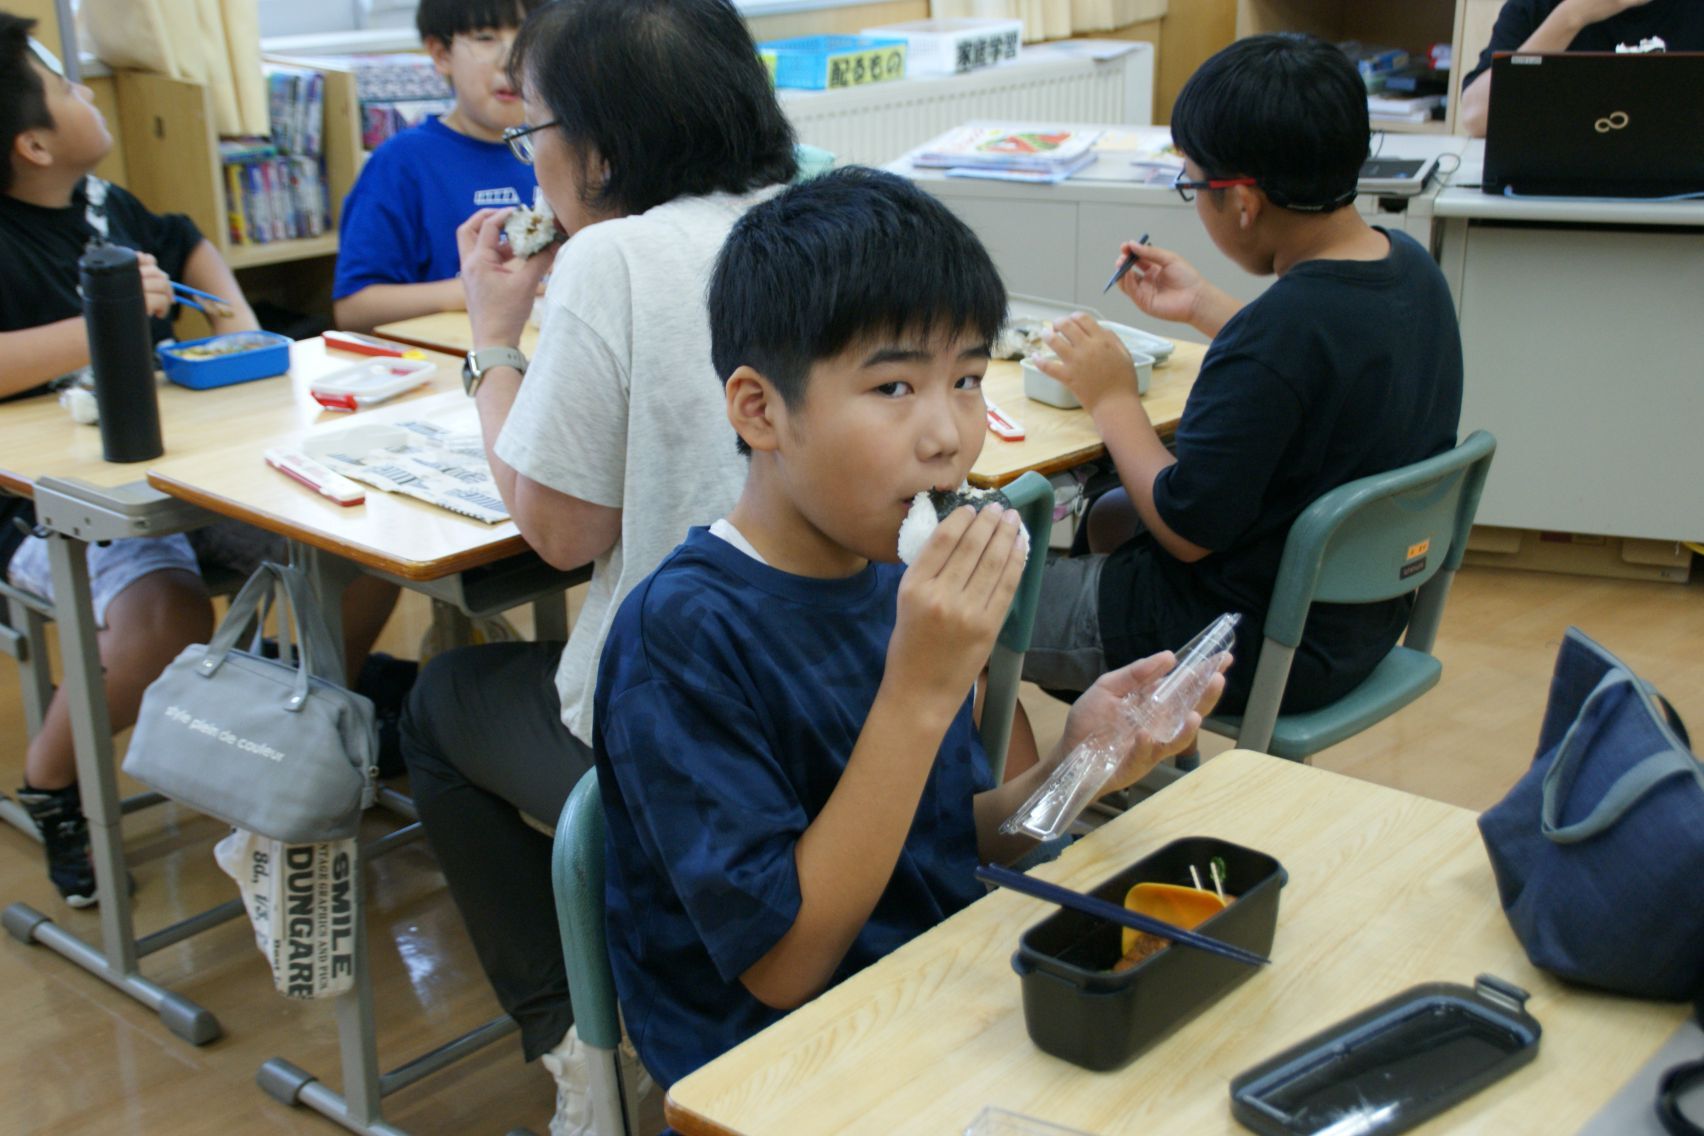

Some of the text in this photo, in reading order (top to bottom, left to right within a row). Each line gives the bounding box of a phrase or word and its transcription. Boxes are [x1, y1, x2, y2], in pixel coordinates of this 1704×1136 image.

[831, 51, 902, 87] 配るもの
[219, 729, 237, 745] de
[318, 882, 328, 937] GRAPHICS
[332, 852, 352, 979] SMILE
[318, 941, 328, 963] AND
